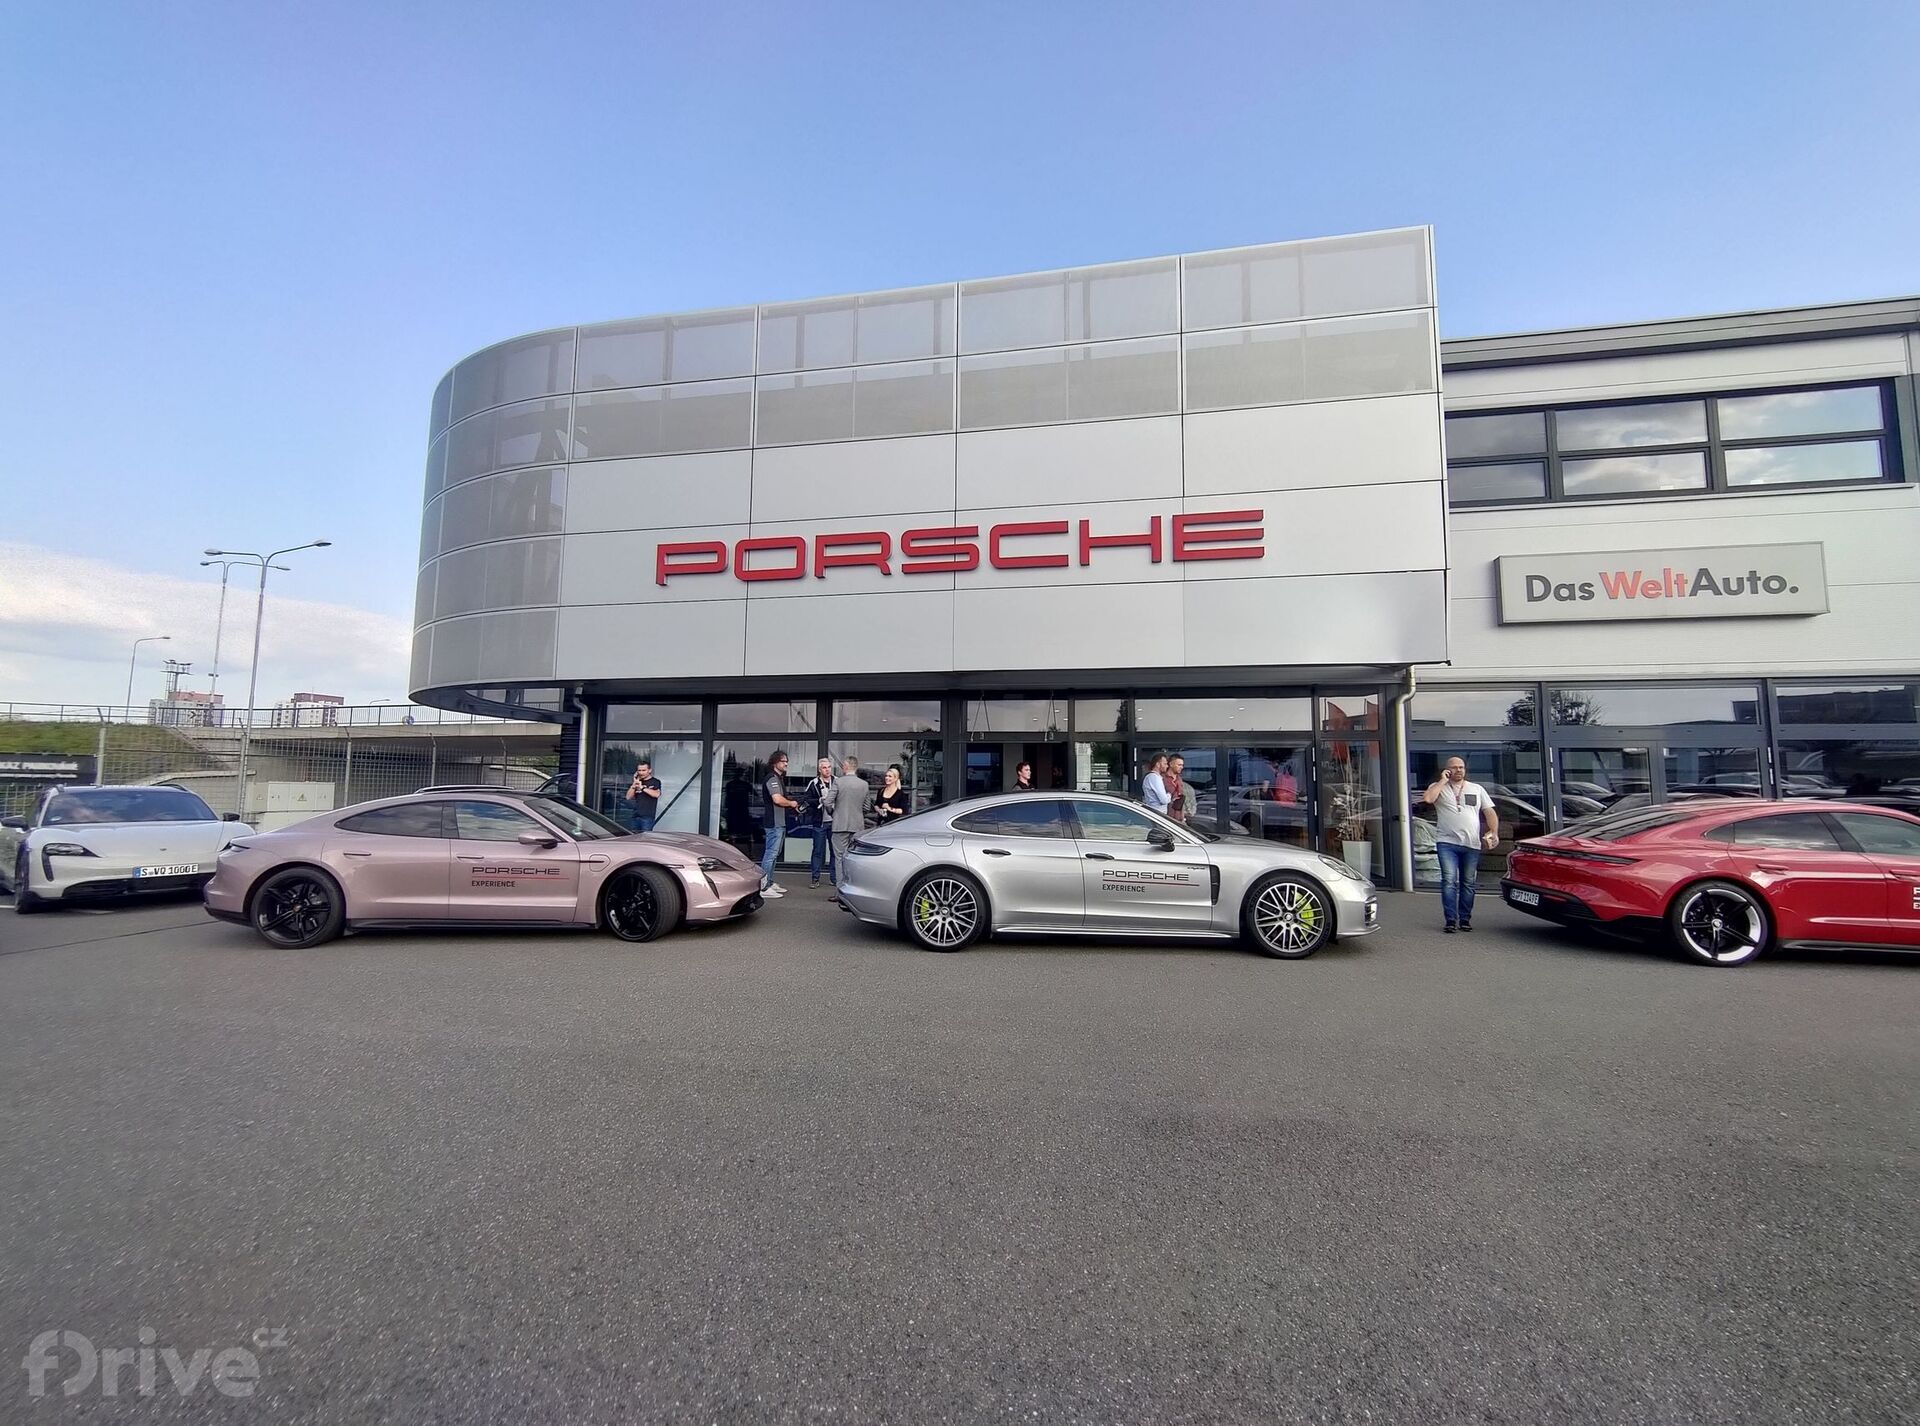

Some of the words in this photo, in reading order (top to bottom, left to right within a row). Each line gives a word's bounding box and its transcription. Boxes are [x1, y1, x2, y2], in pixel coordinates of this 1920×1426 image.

[656, 509, 1265, 586] PORSCHE
[1525, 574, 1596, 603] Das
[472, 867, 560, 875] PORSCHE
[1103, 870, 1189, 881] PORSCHE
[1102, 884, 1146, 893] EXPERIENCE
